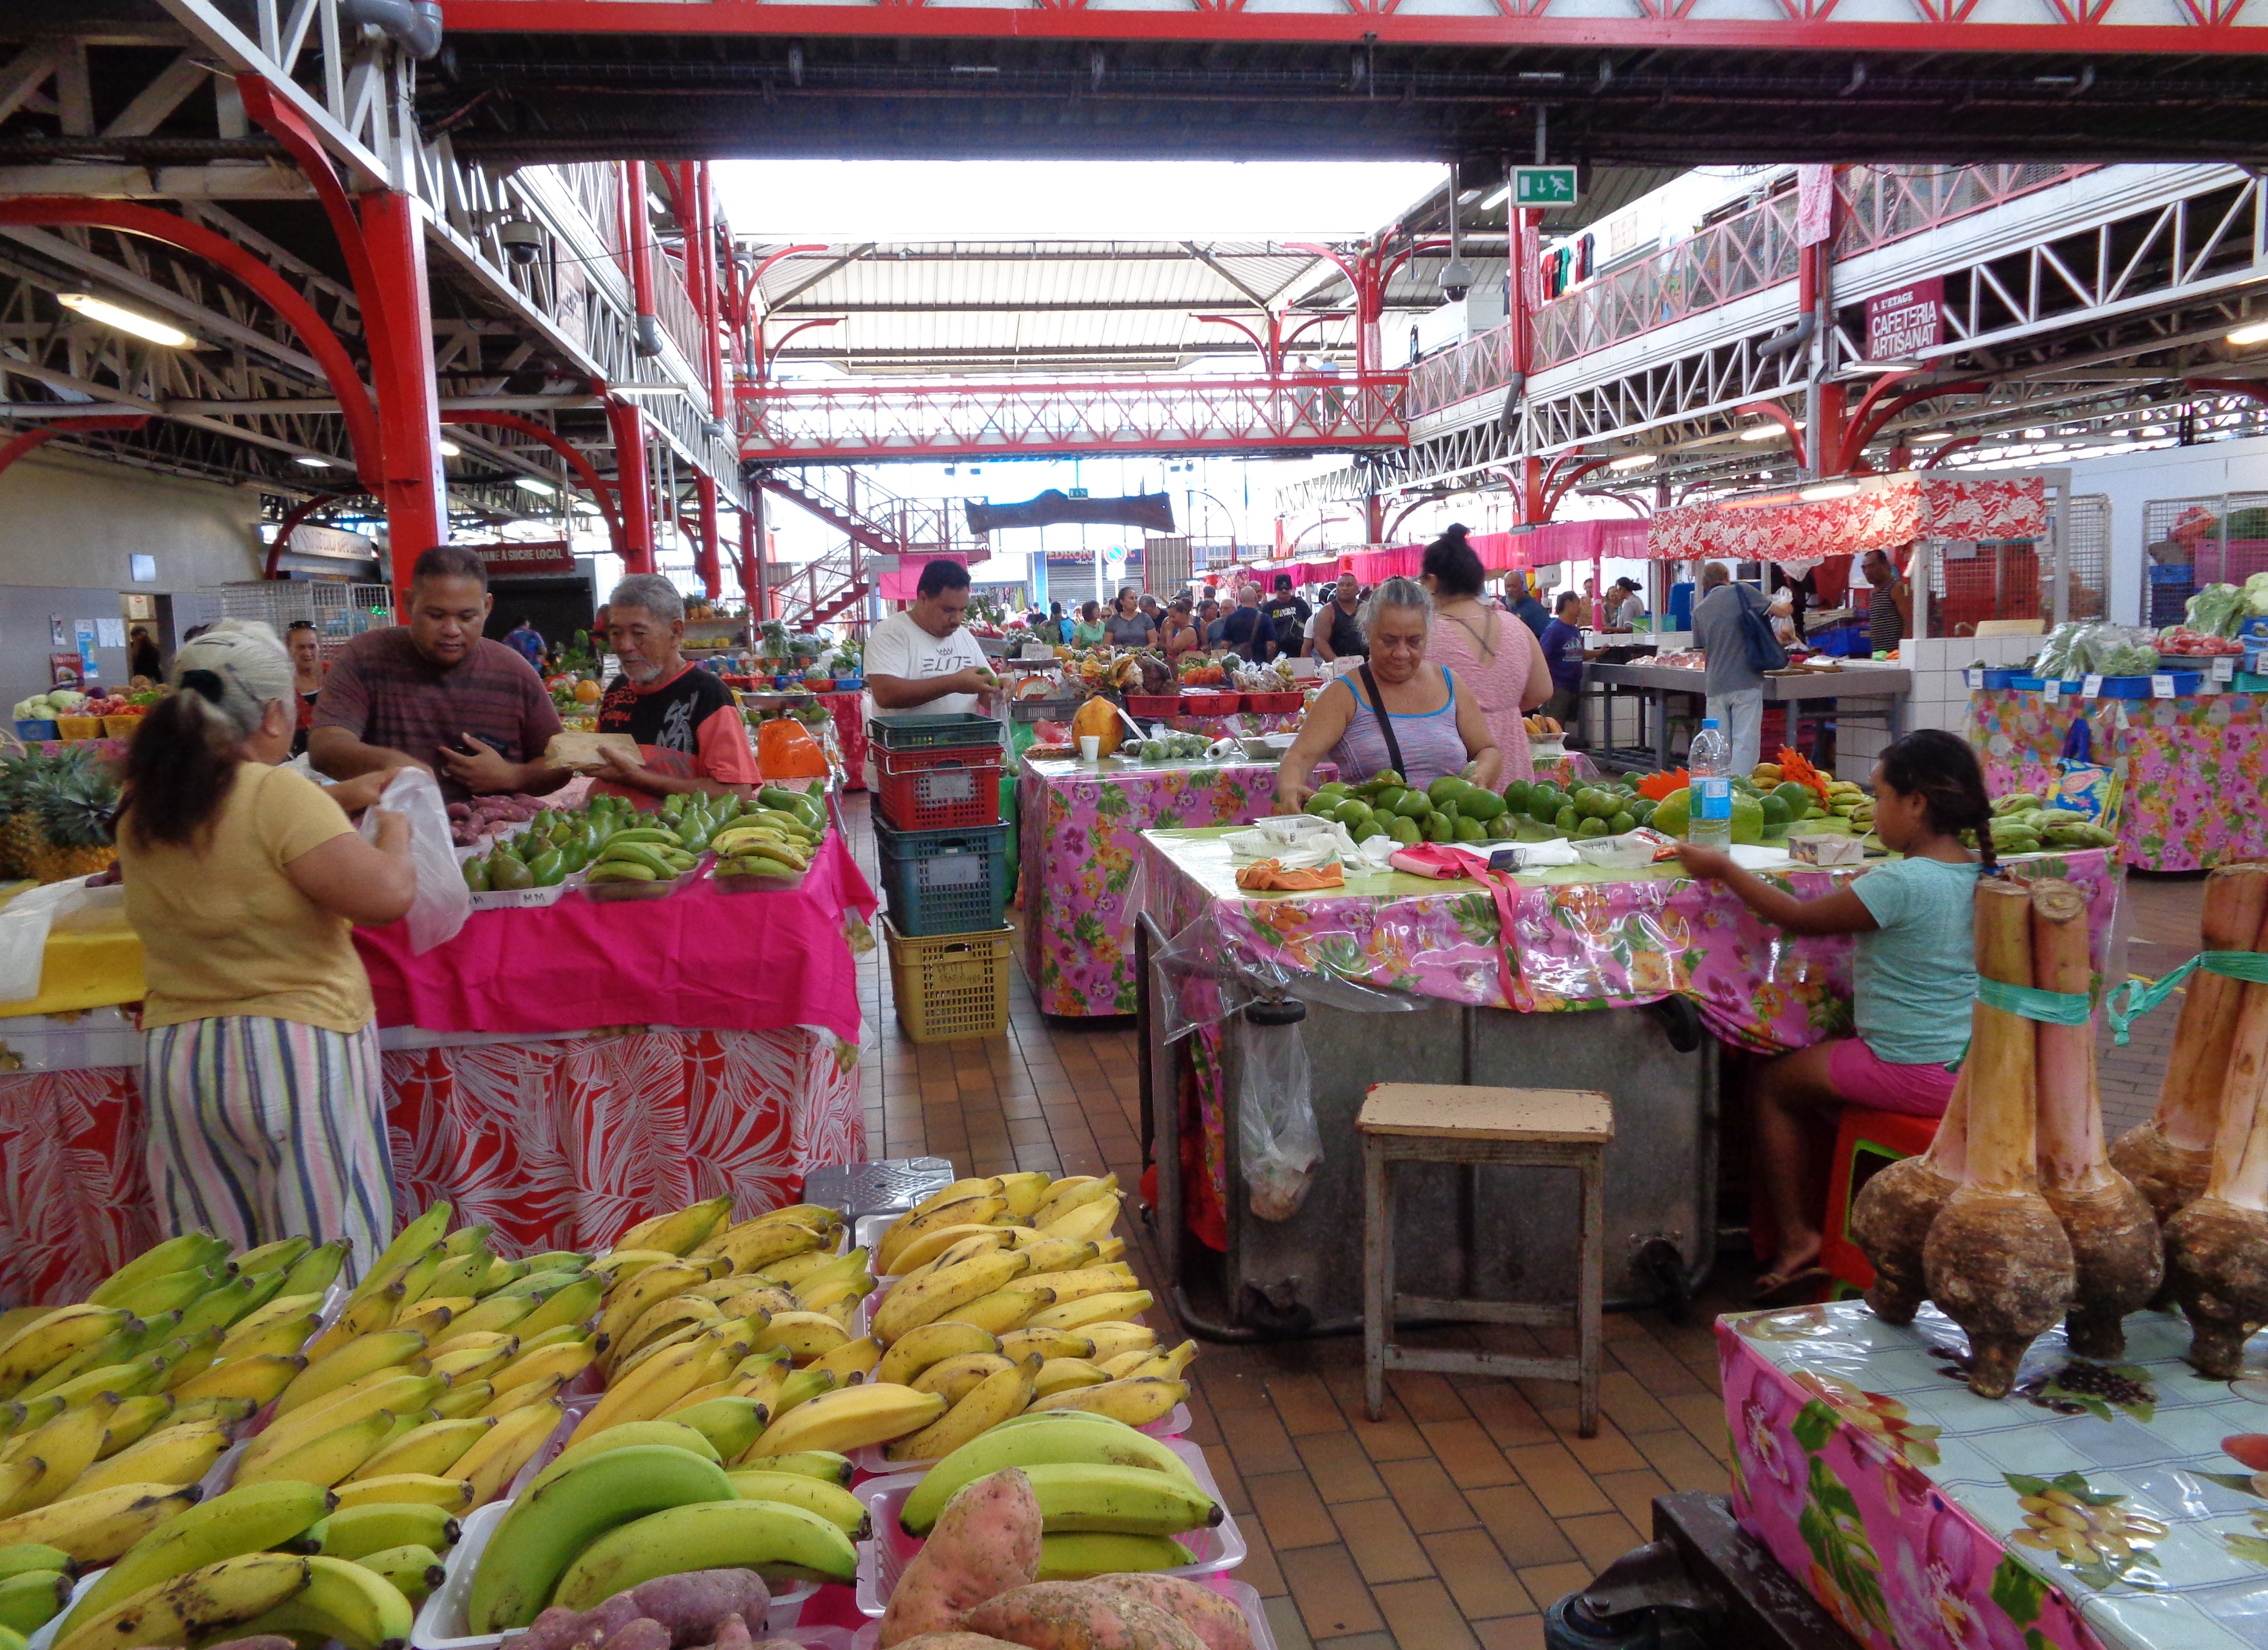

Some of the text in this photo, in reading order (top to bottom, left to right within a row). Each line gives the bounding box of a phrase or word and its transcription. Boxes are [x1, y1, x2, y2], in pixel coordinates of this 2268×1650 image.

[1872, 302, 1878, 312] A
[1872, 300, 1937, 337] CAFETERIA
[1871, 323, 1937, 359] ARTISANAT
[508, 549, 534, 560] SUCRE
[536, 548, 564, 559] LOCAL
[920, 656, 972, 672] ELITE
